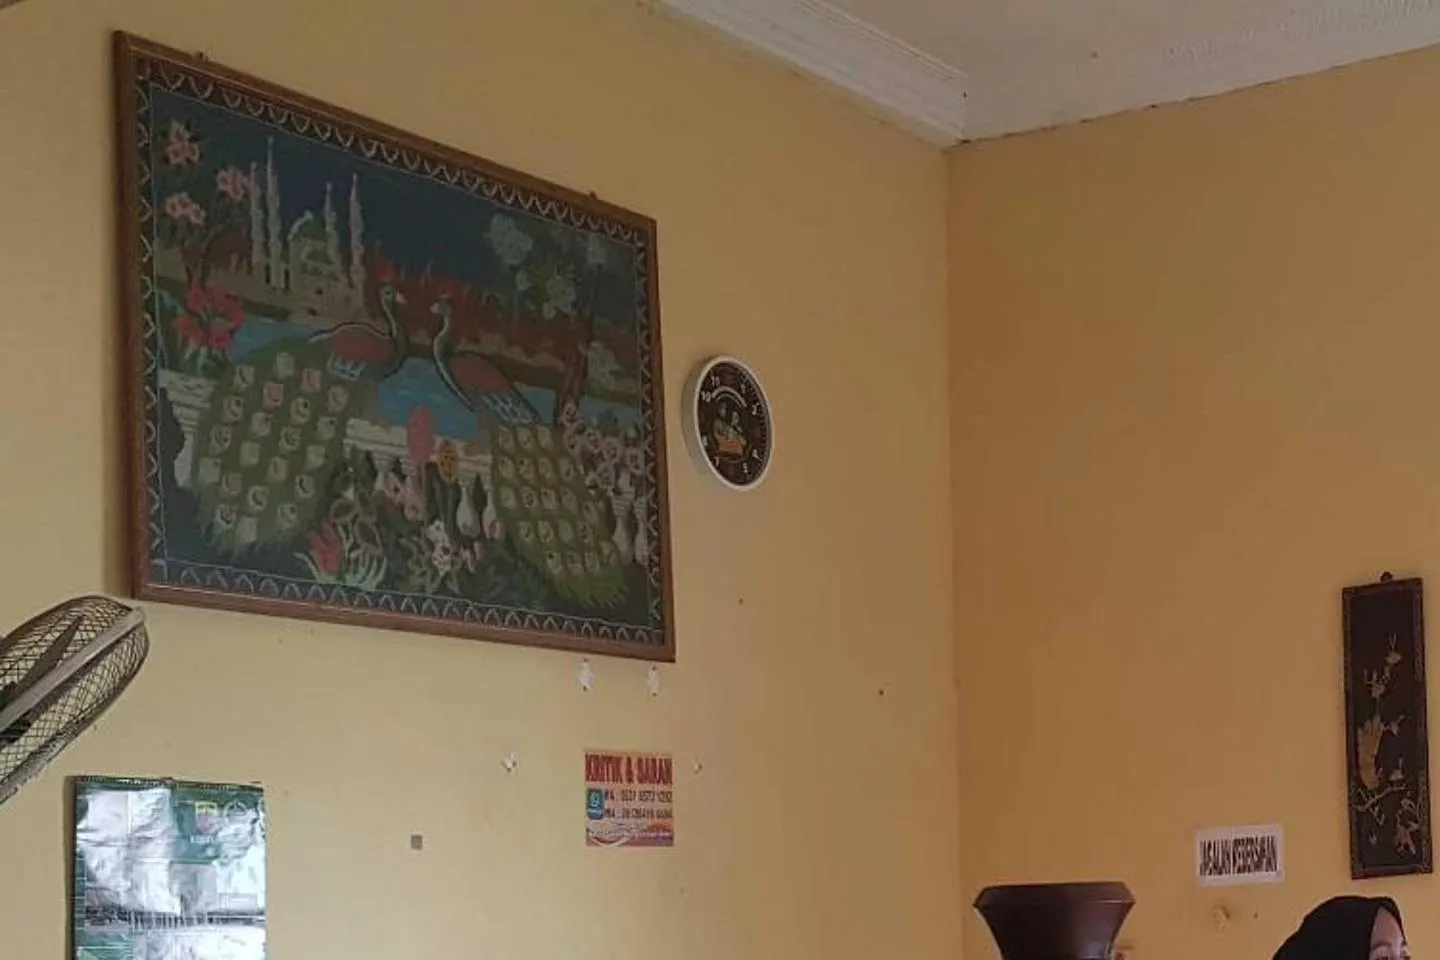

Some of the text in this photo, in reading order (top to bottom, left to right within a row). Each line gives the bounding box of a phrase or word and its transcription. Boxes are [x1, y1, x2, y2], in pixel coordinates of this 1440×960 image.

[585, 753, 673, 785] KRITIK & SARAN
